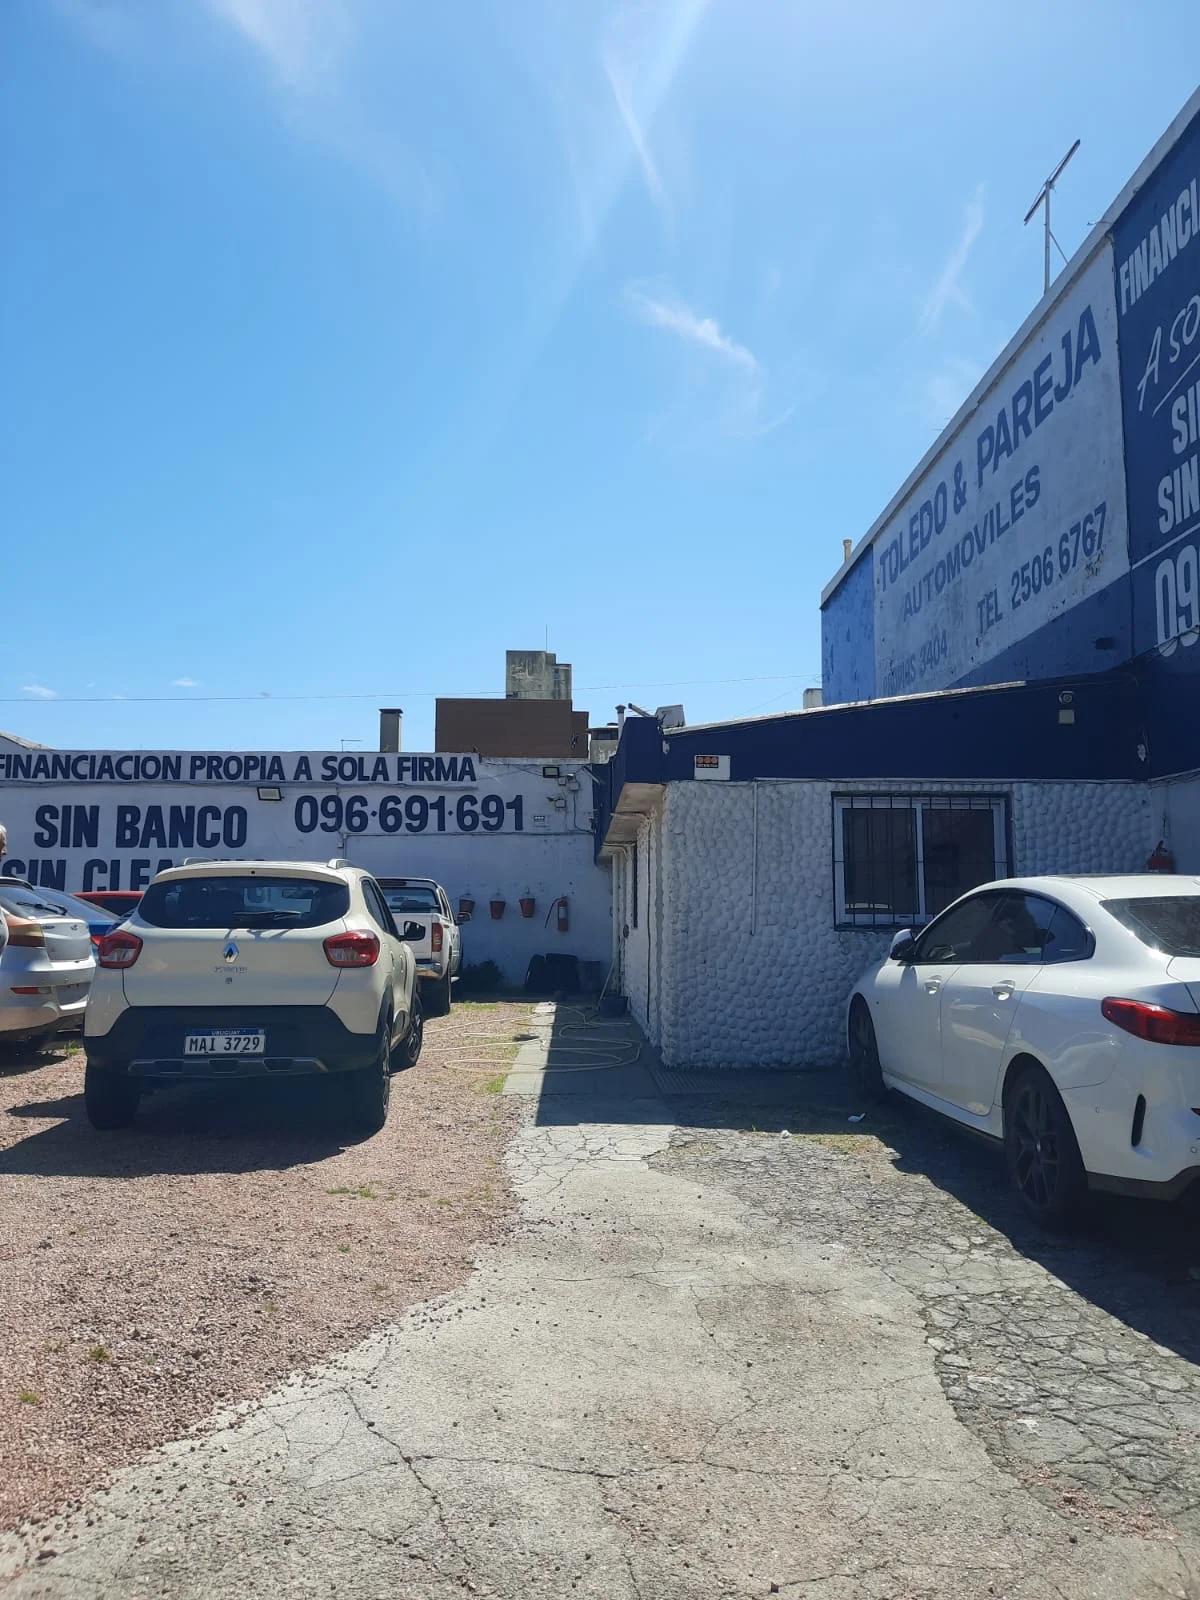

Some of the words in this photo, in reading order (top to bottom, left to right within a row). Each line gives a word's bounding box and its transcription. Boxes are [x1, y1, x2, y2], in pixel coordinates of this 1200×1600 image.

[1119, 176, 1200, 316] FINANCI
[1137, 326, 1162, 411] A
[879, 481, 948, 593] TOLEDO
[953, 460, 968, 515] &
[977, 304, 1102, 489] PAREJA
[1172, 379, 1200, 454] SI
[1158, 453, 1200, 534] SIN
[903, 464, 1041, 623] AUTOMOVILES
[977, 587, 1003, 635] TEL
[1011, 545, 1054, 610] 2506
[1059, 501, 1107, 574] 6767
[1155, 544, 1200, 657] 09
[189, 755, 286, 781] PROPIA
[293, 755, 313, 781] A
[321, 755, 390, 782] SOLA
[397, 756, 477, 782] FIRMA
[34, 804, 100, 848] SIN
[115, 804, 248, 849] BANCO
[189, 1037, 216, 1052] MAI
[223, 1036, 260, 1051] 3729
